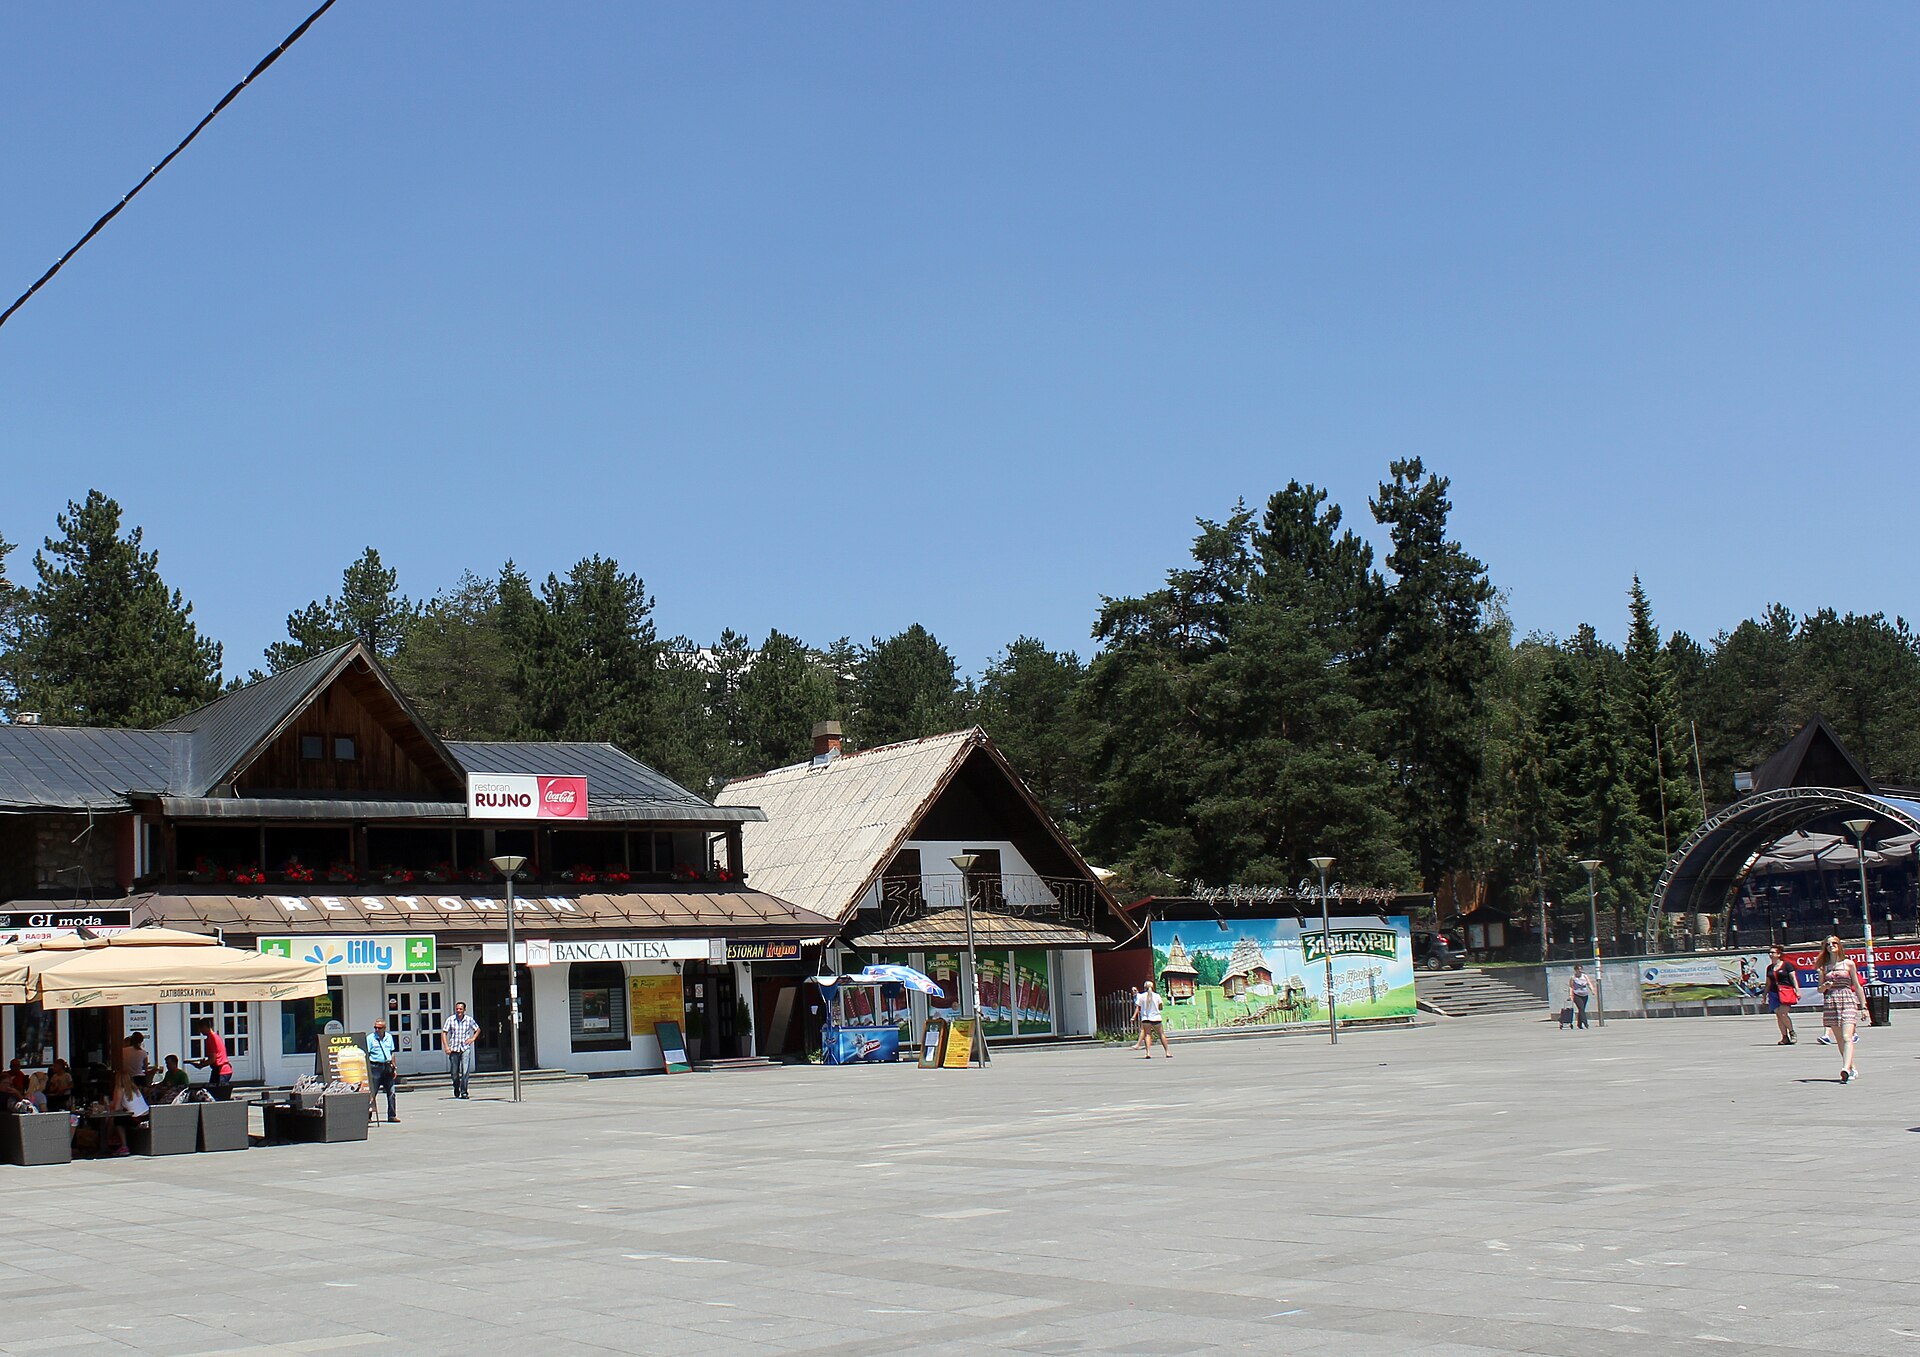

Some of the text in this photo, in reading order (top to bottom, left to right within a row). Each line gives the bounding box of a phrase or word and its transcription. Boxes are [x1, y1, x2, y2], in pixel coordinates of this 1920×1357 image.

[474, 784, 510, 792] restoran
[475, 793, 532, 807] RUJNO
[279, 896, 577, 912] RESTORAN
[28, 914, 102, 927] GI moda
[347, 940, 392, 970] lilly
[556, 942, 670, 960] BANCA INTESA
[726, 944, 765, 958] ESTORAN
[160, 987, 216, 998] ZLATIBORSKA PIVNICA
